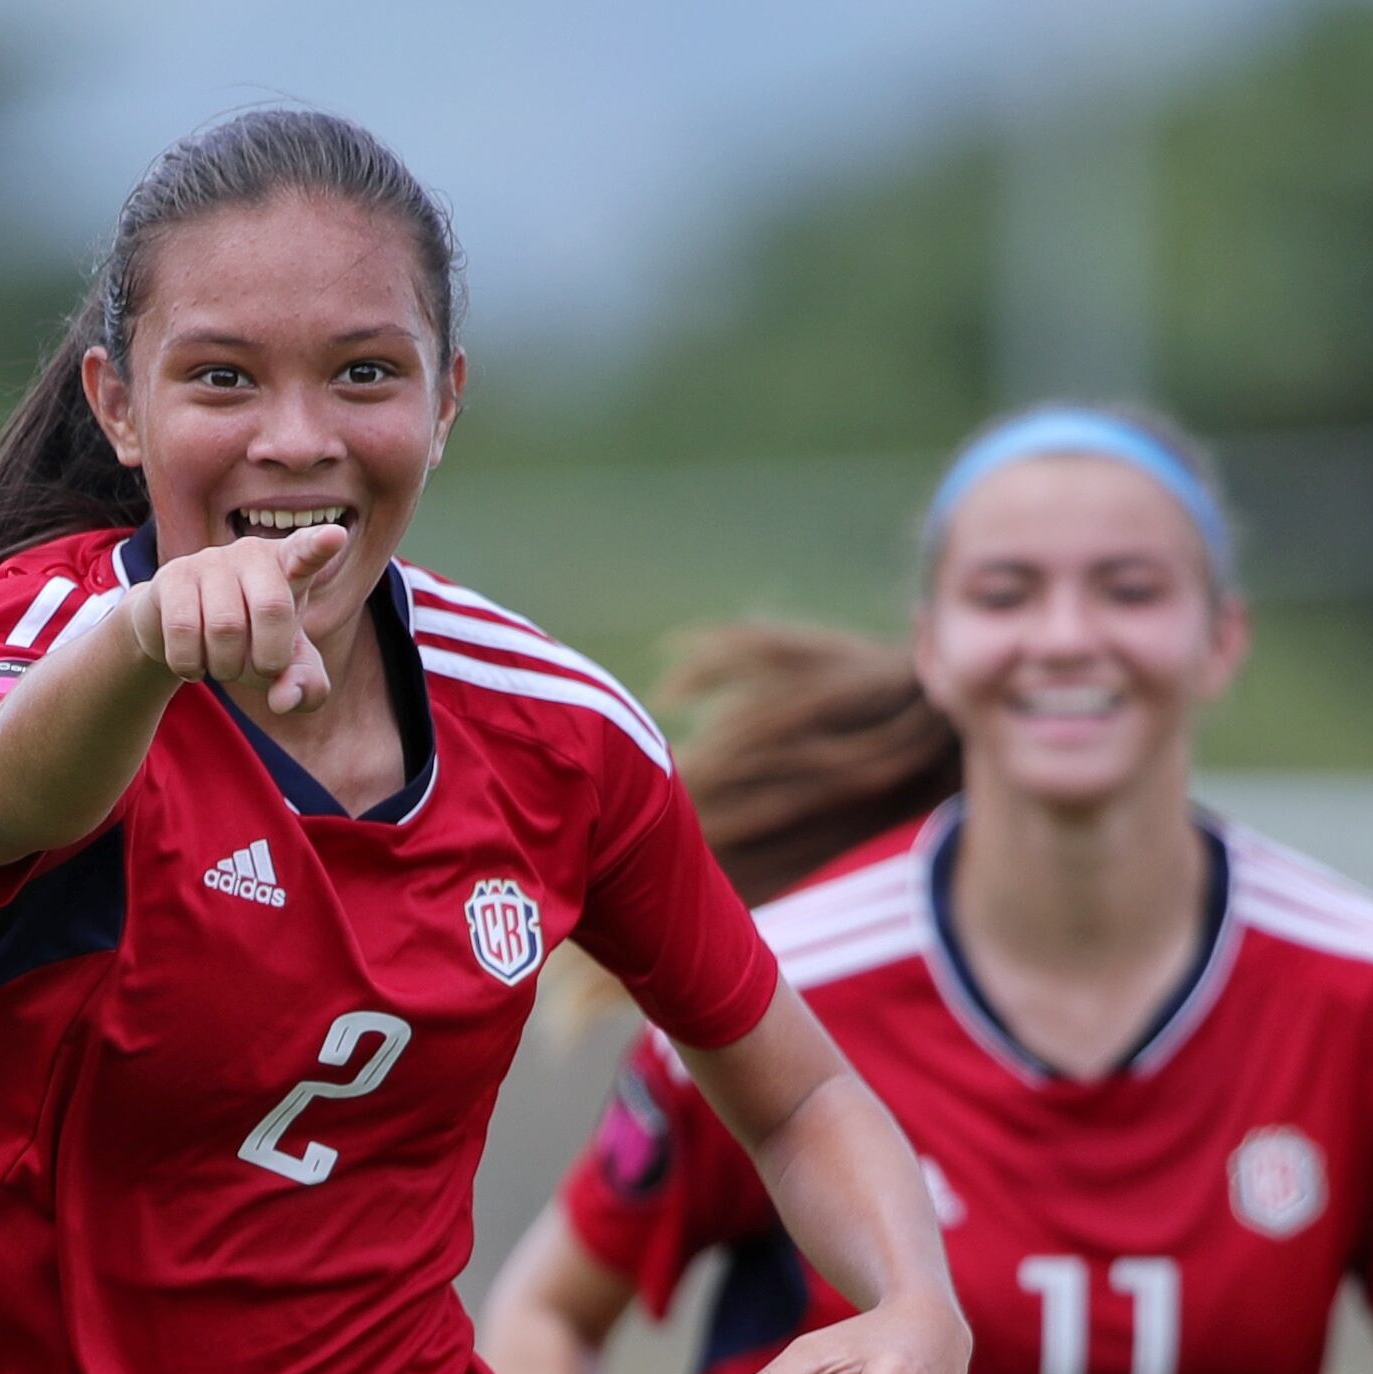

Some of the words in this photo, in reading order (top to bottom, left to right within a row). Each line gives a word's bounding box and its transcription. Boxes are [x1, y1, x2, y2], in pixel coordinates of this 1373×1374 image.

[204, 868, 286, 908] adidas
[481, 902, 523, 964] CR
[238, 1011, 411, 1185] 2
